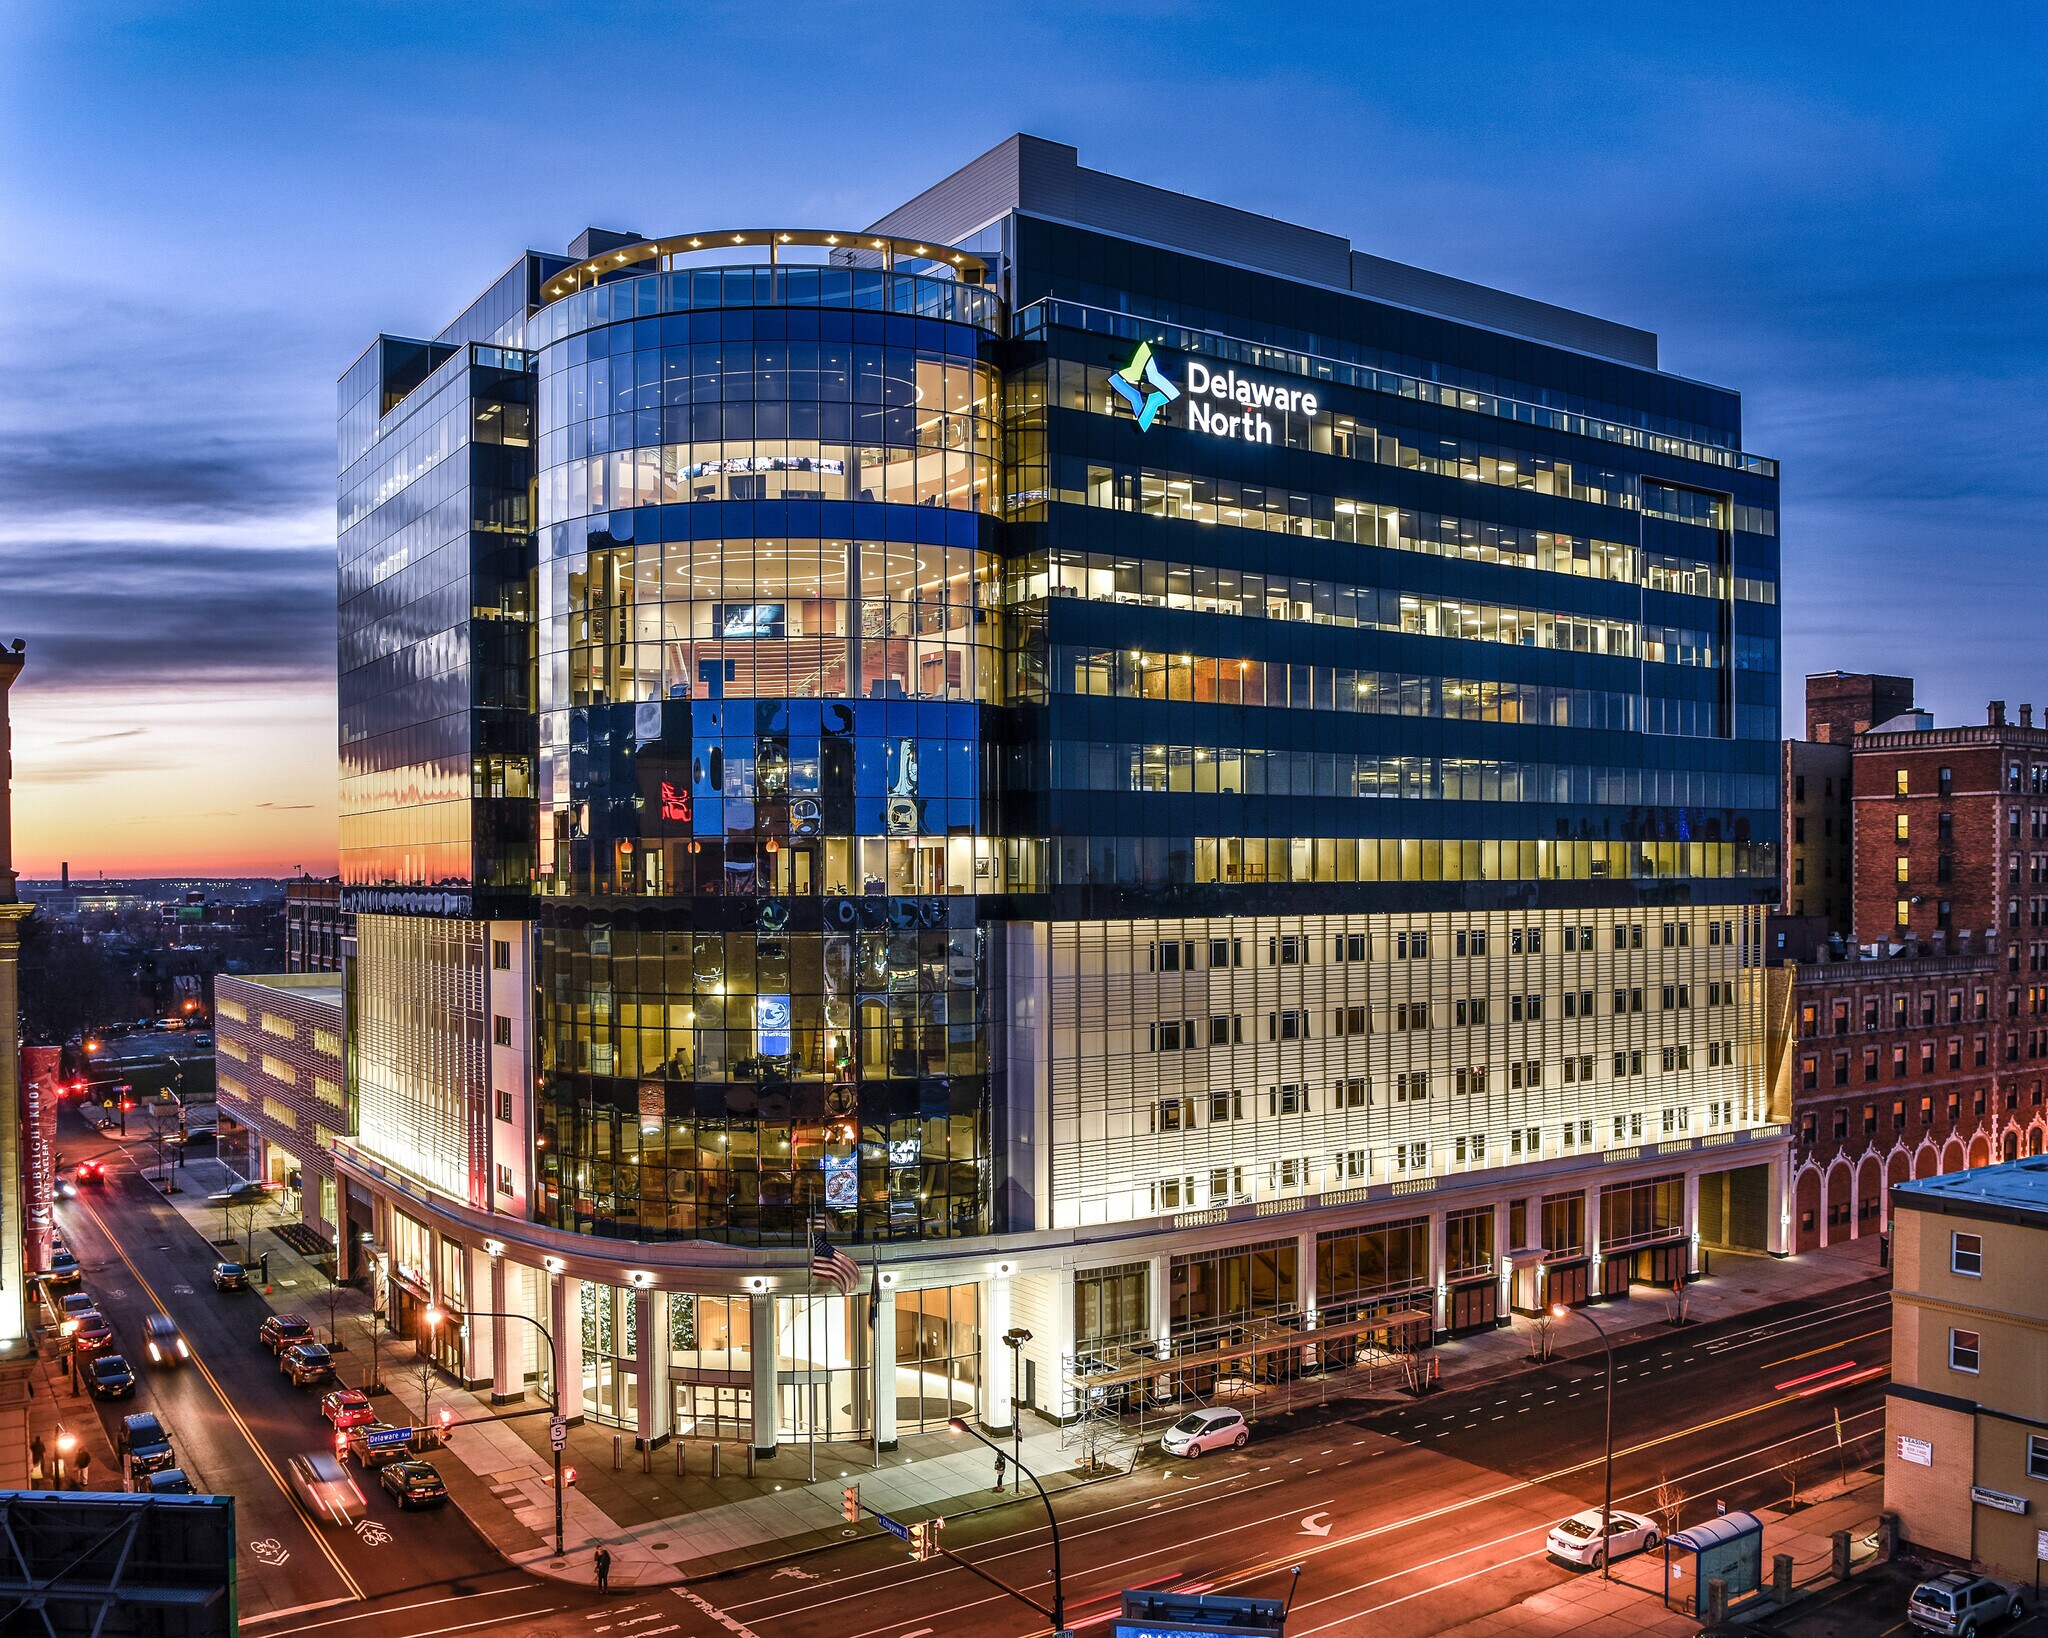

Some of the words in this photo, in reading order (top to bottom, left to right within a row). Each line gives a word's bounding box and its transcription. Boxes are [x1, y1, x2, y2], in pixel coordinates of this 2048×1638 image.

[1189, 362, 1318, 416] Delaware
[1189, 400, 1272, 444] North
[555, 1427, 562, 1436] 5
[370, 1433, 399, 1442] Delaware
[1905, 1437, 1930, 1448] LEASING
